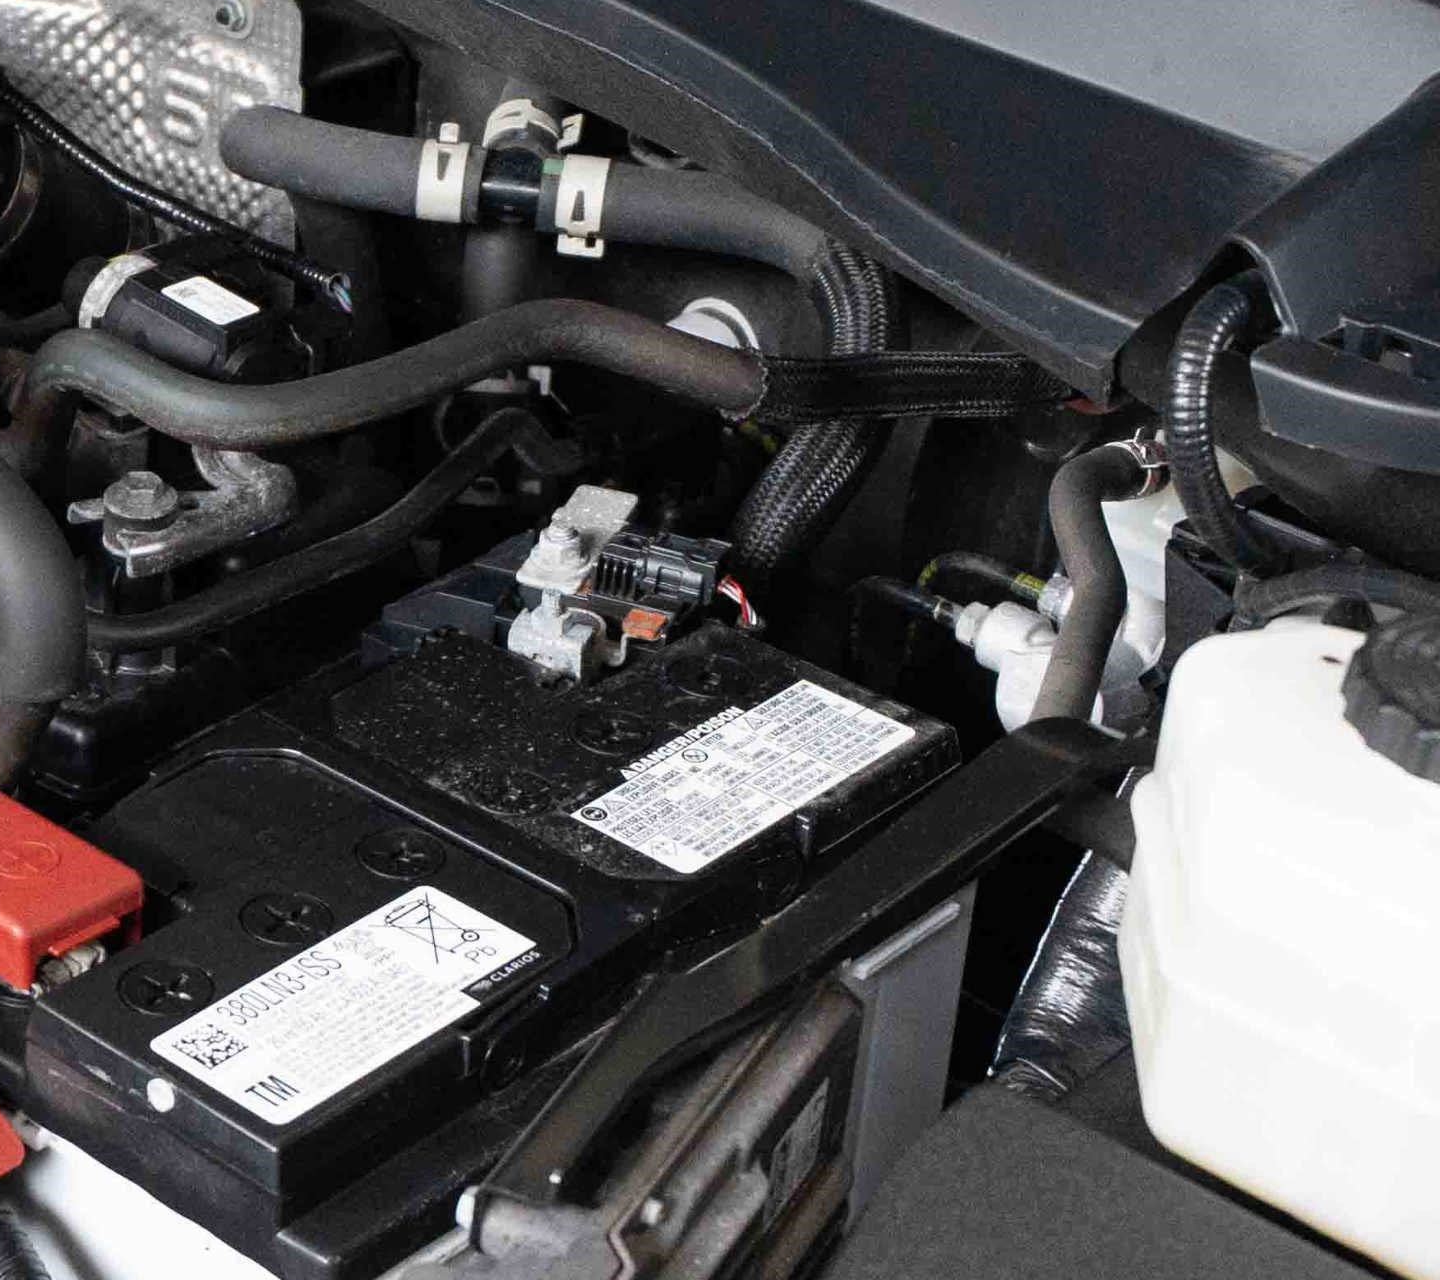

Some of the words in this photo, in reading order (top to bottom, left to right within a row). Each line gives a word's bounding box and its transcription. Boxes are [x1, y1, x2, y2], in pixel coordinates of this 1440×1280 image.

[629, 706, 745, 773] DANGER/POISON
[465, 945, 498, 964] Pb
[489, 950, 540, 982] CLARIOS
[216, 951, 342, 1026] 380LN3-ISS
[244, 1074, 301, 1107] TM
